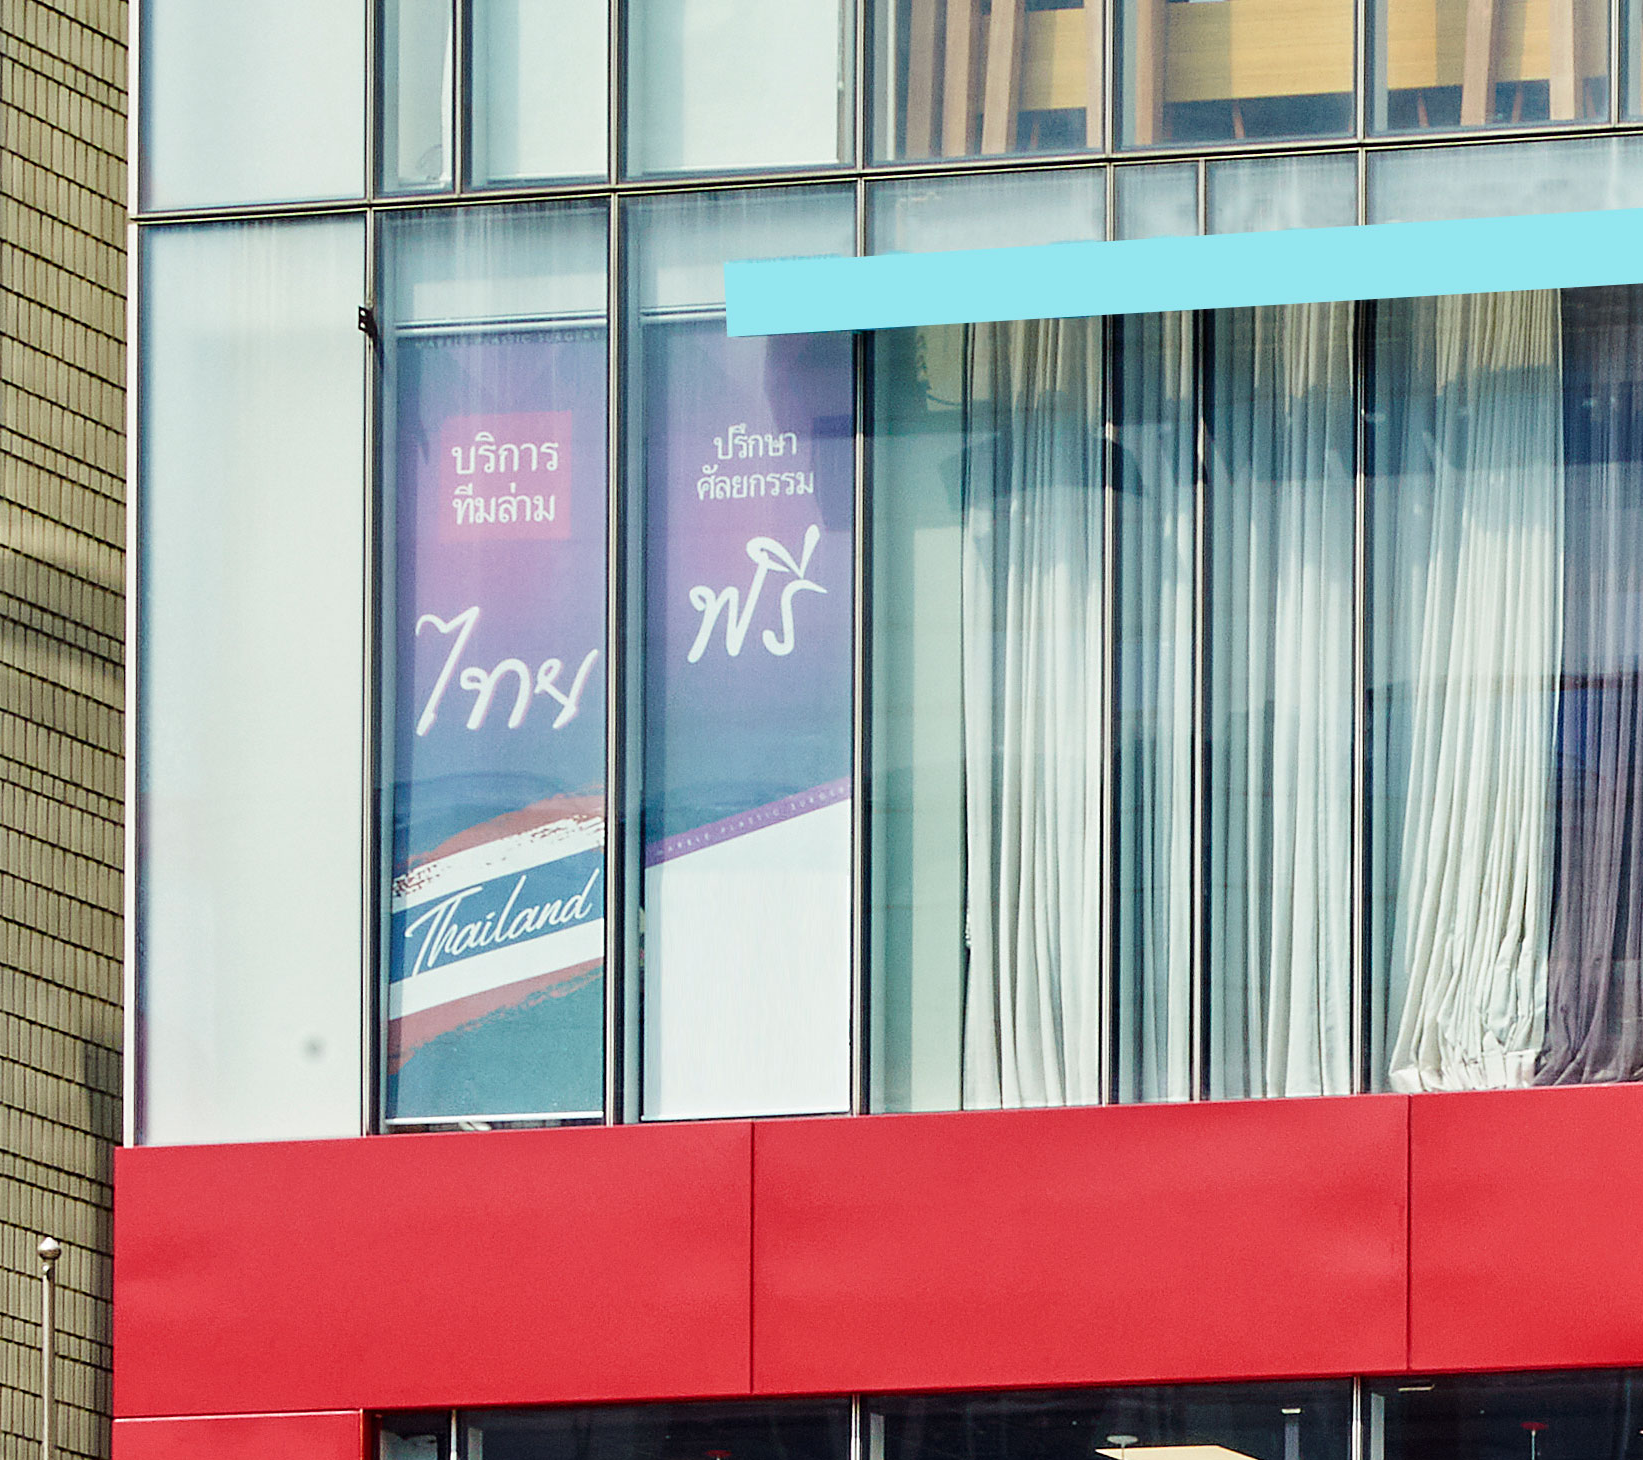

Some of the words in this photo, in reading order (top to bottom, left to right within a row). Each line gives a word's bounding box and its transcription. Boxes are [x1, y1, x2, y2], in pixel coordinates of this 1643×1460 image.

[451, 431, 561, 474] บริการ
[713, 423, 799, 461] ปรึกษา
[697, 464, 816, 501] ศัลยกรรม
[451, 484, 558, 526] ทีมล่าม
[688, 524, 829, 664] ฟรี
[415, 605, 600, 738] ไทย
[405, 866, 595, 978] Thailand
